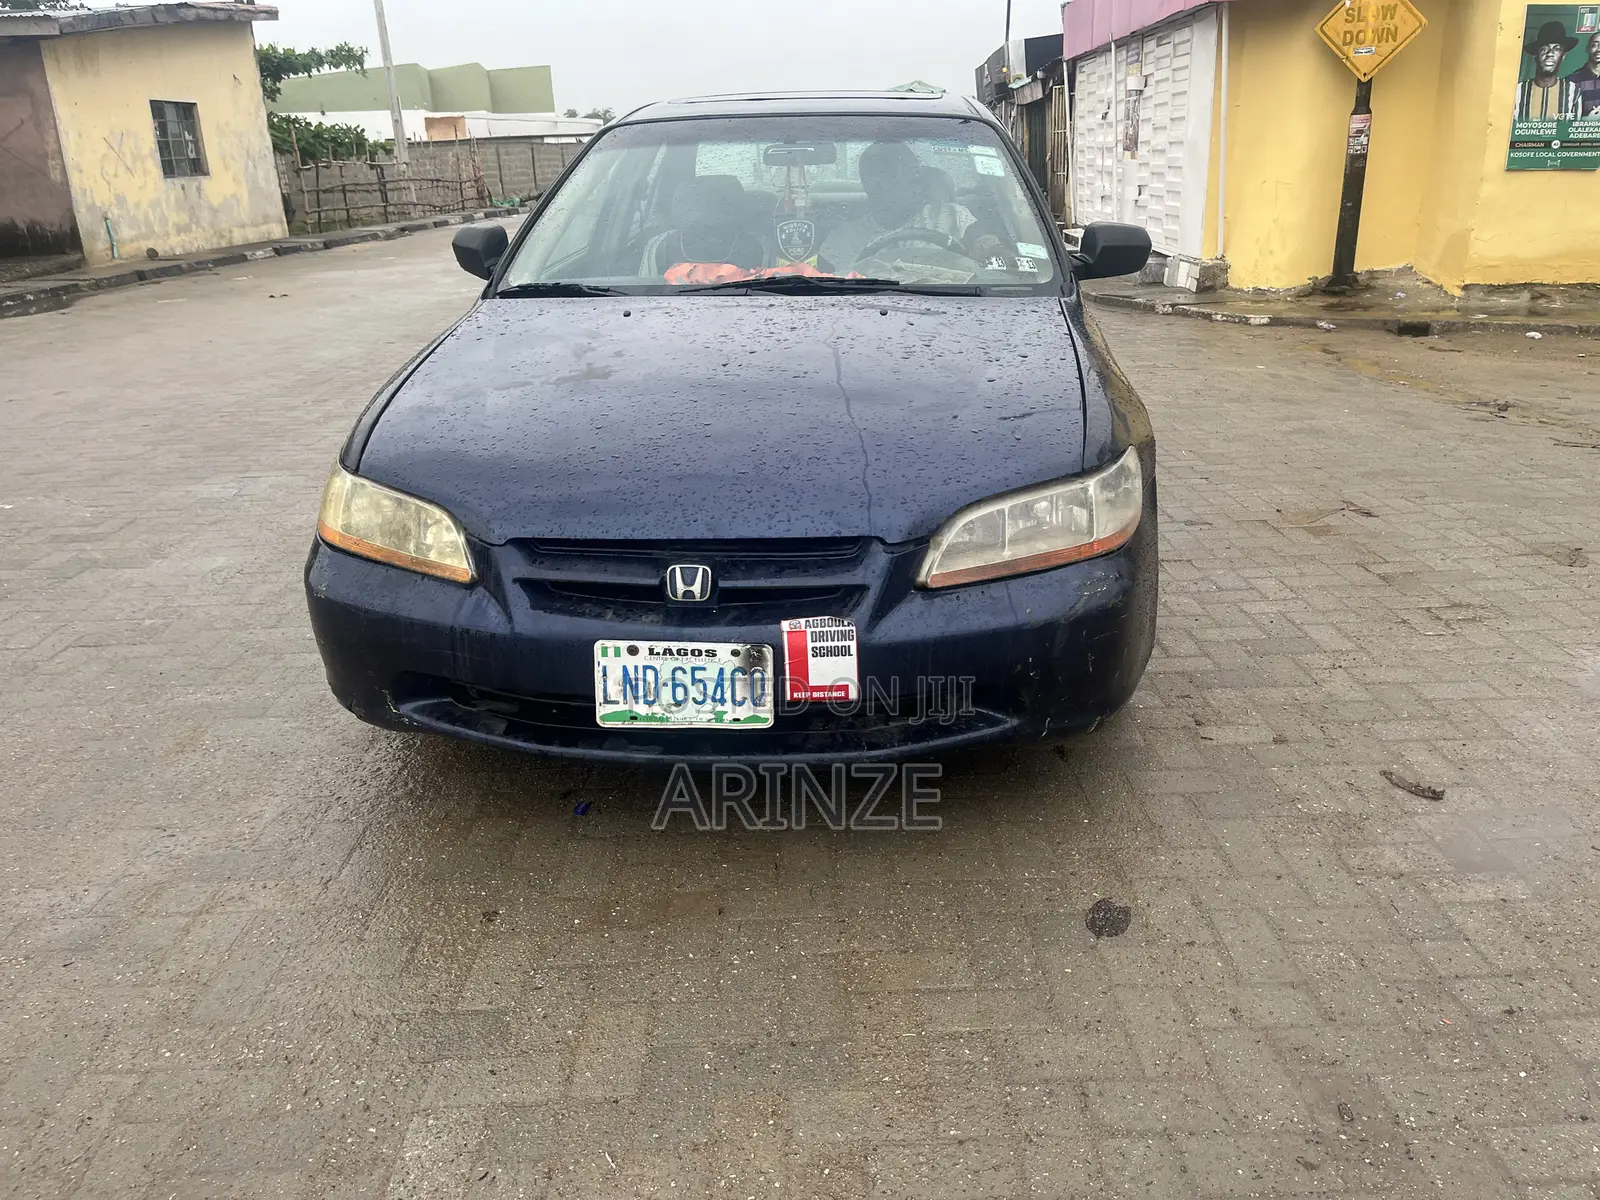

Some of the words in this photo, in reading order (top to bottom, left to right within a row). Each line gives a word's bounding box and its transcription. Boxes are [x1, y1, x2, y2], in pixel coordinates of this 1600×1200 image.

[1342, 27, 1398, 46] DOWN
[1515, 121, 1557, 129] MOYOSORE
[1514, 128, 1557, 136] OGUNLEWE
[810, 629, 855, 643] DRIVING
[648, 647, 718, 658] LAGOS
[811, 645, 854, 658] SCHOOL
